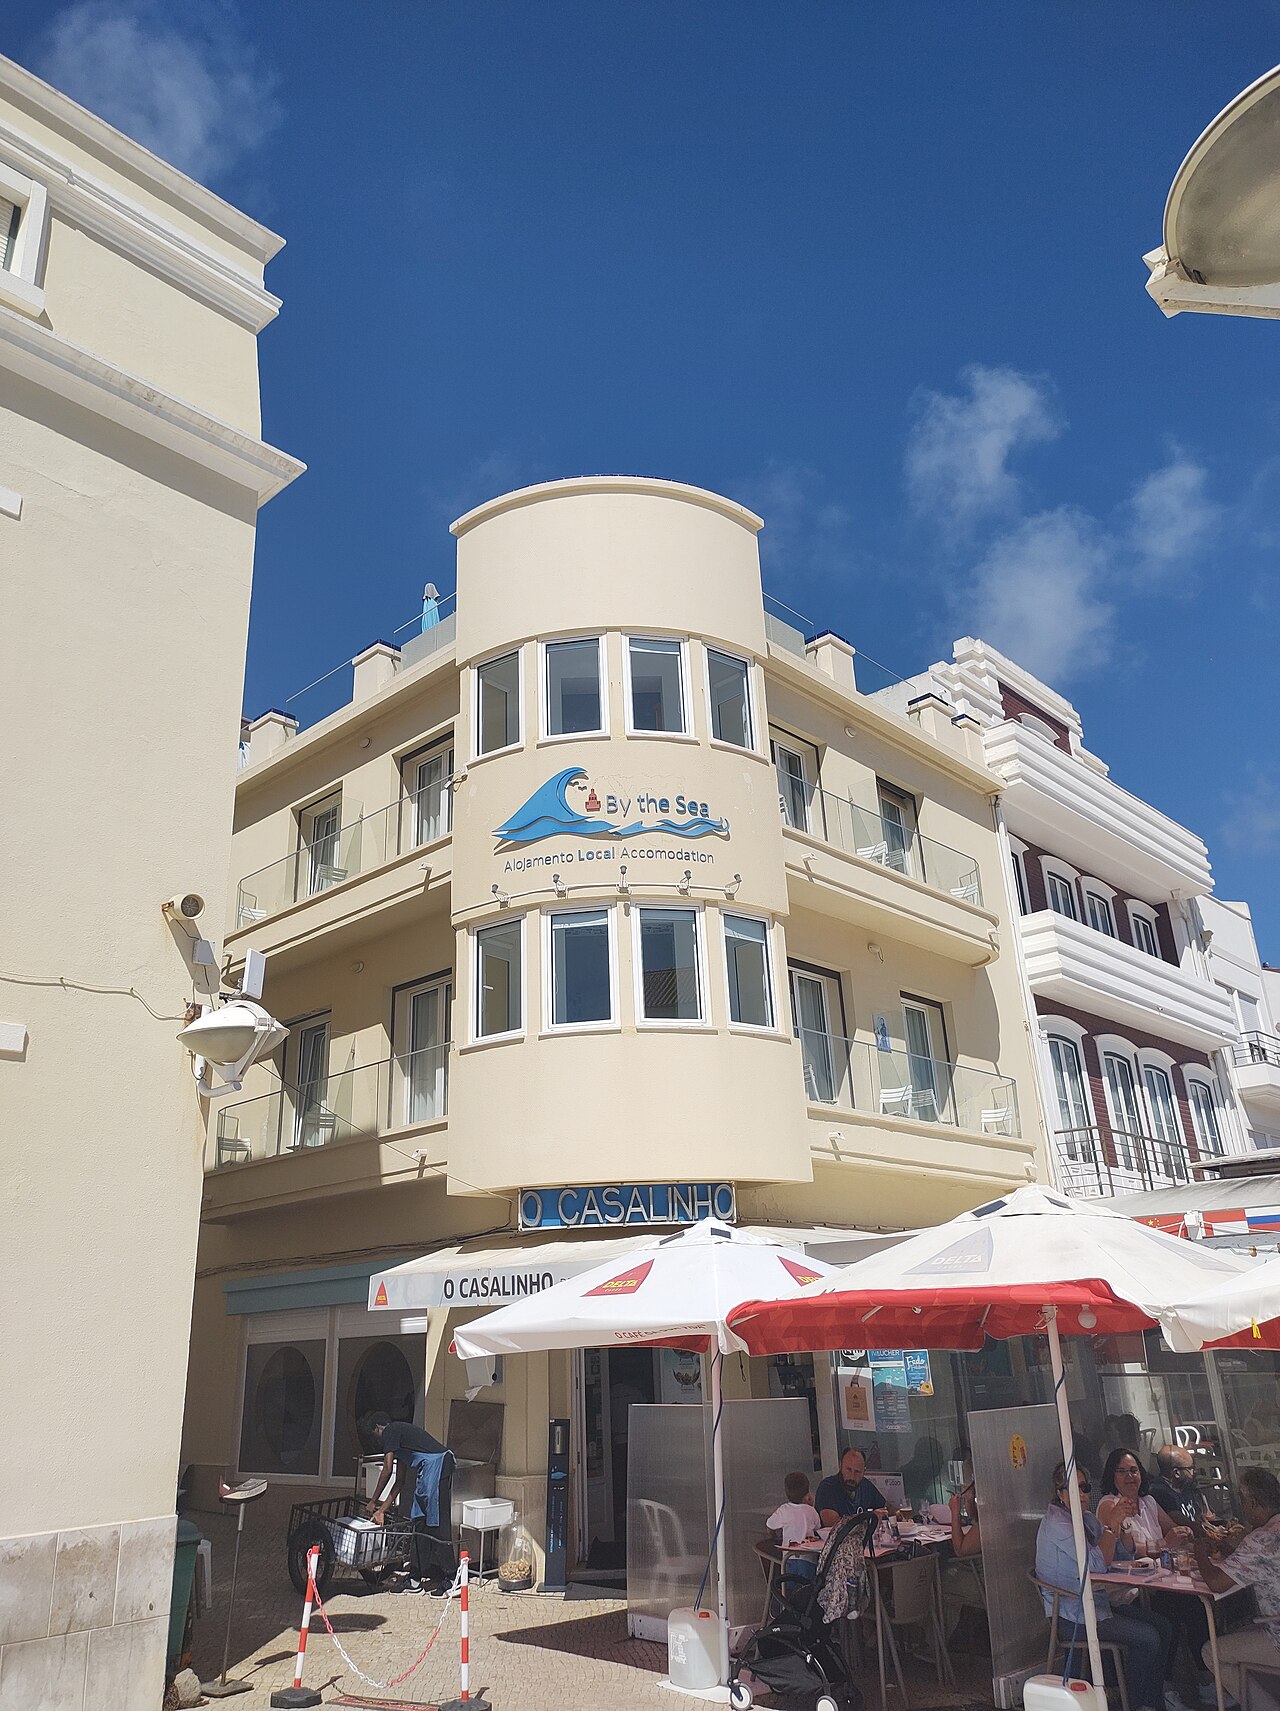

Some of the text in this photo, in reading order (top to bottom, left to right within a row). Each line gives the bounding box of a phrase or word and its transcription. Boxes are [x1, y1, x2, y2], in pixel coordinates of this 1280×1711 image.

[606, 793, 710, 817] By the Sea
[504, 847, 714, 873] Alojamento Local Accomodation
[521, 1183, 735, 1227] O CASALINHO
[931, 1254, 983, 1266] DELTA
[443, 1272, 554, 1299] O CASALINHO
[602, 1279, 638, 1289] DELTA
